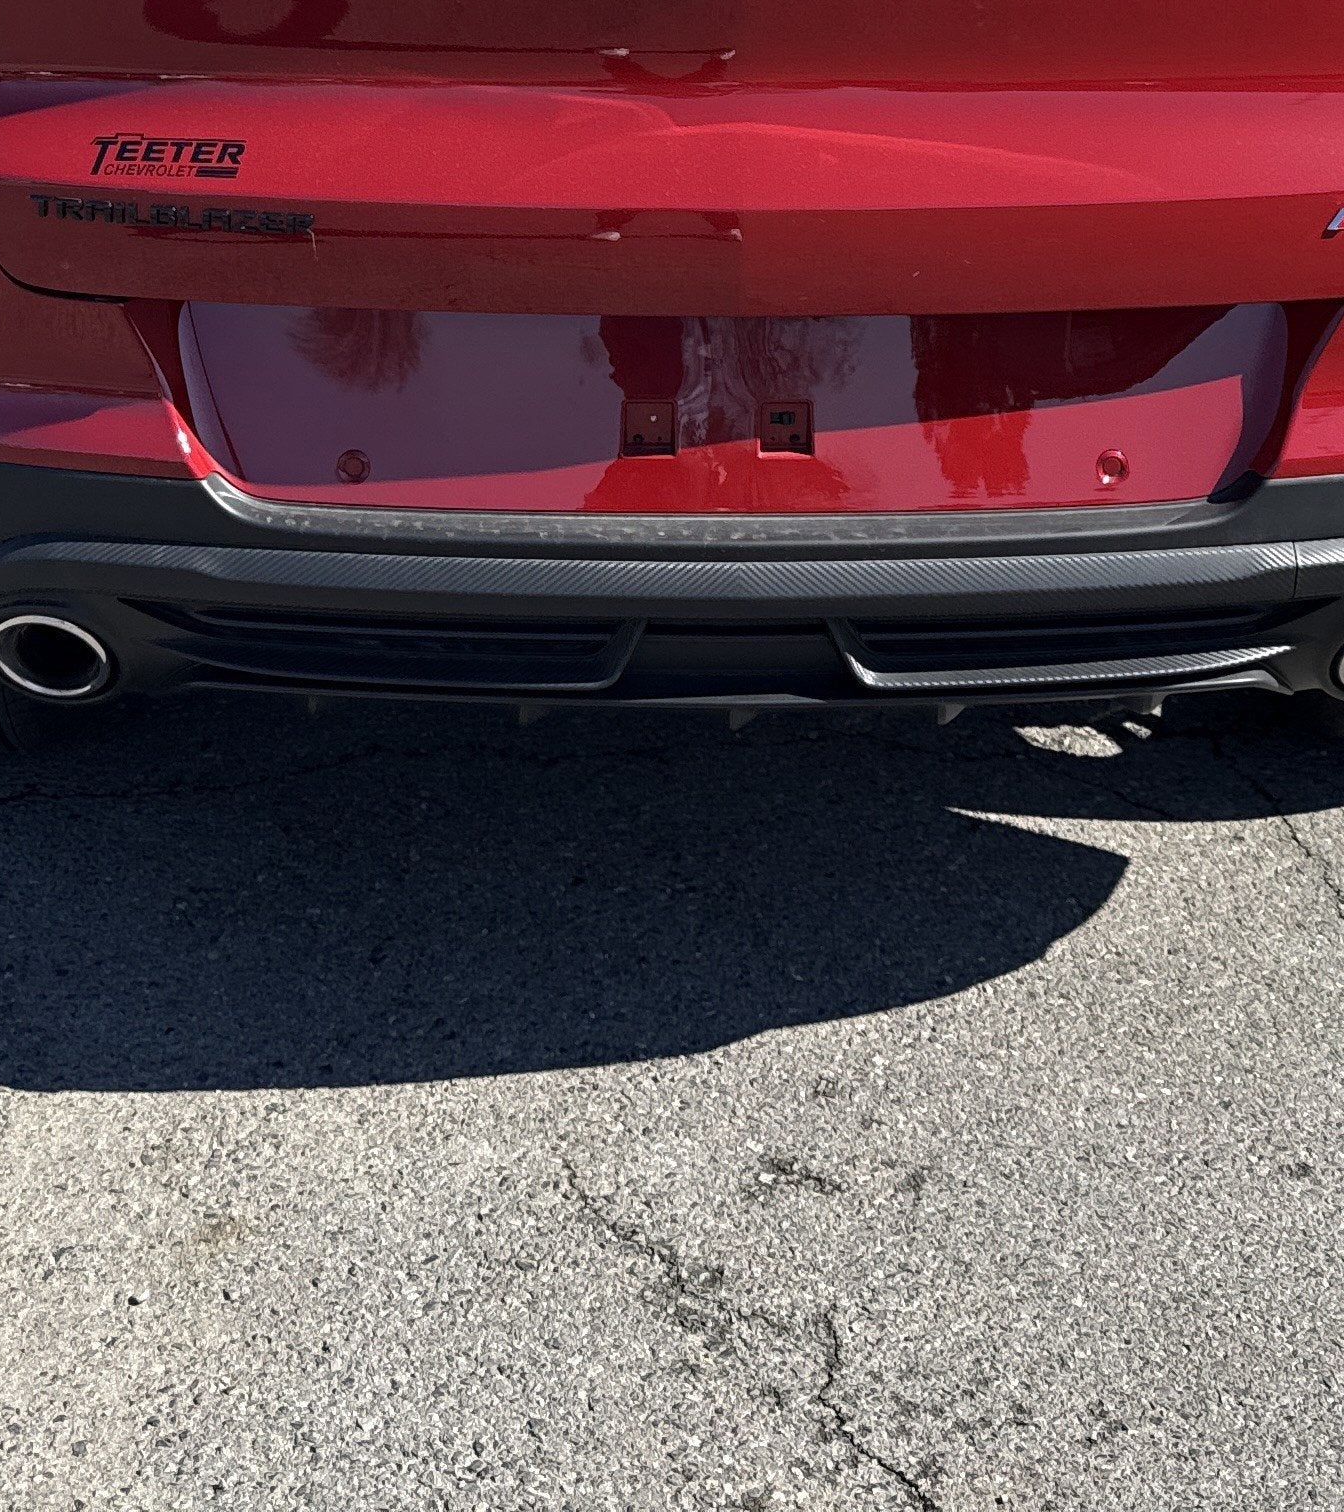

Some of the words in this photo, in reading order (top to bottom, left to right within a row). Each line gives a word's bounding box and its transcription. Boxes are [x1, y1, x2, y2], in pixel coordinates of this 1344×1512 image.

[90, 138, 246, 175] TEETER
[103, 163, 197, 178] CHEVROLET
[28, 194, 315, 233] TRAILBLAZER
